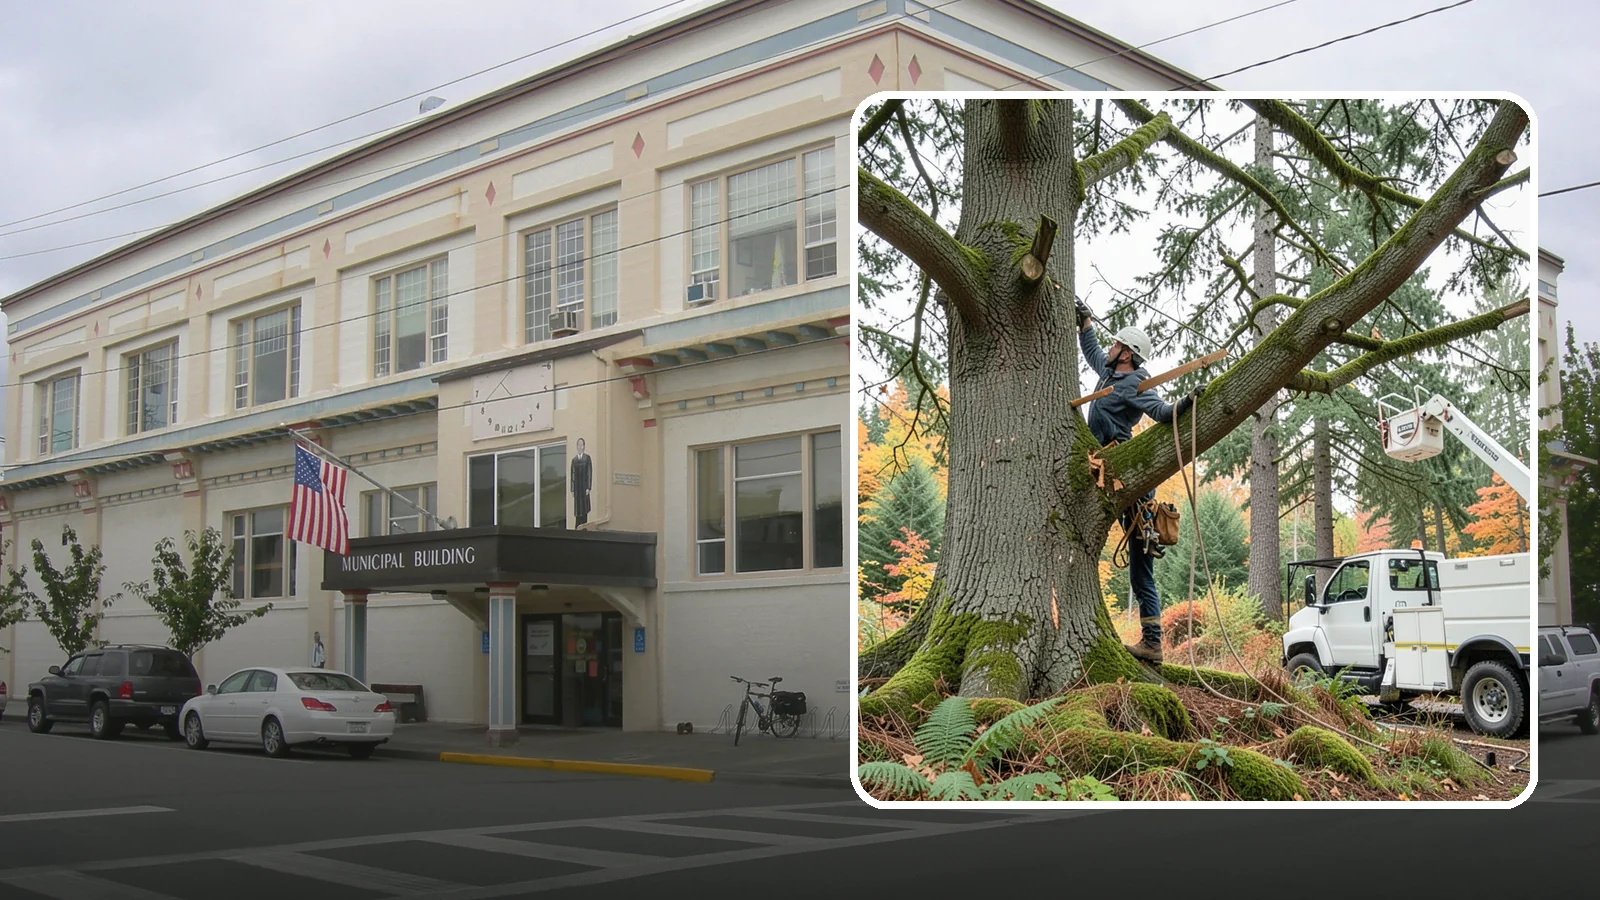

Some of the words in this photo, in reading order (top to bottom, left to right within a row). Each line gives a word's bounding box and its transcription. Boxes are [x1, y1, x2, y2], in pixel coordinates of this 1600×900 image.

[488, 418, 492, 426] 9
[342, 553, 405, 572] MUNICIPAL
[414, 546, 475, 566] BUILDING
